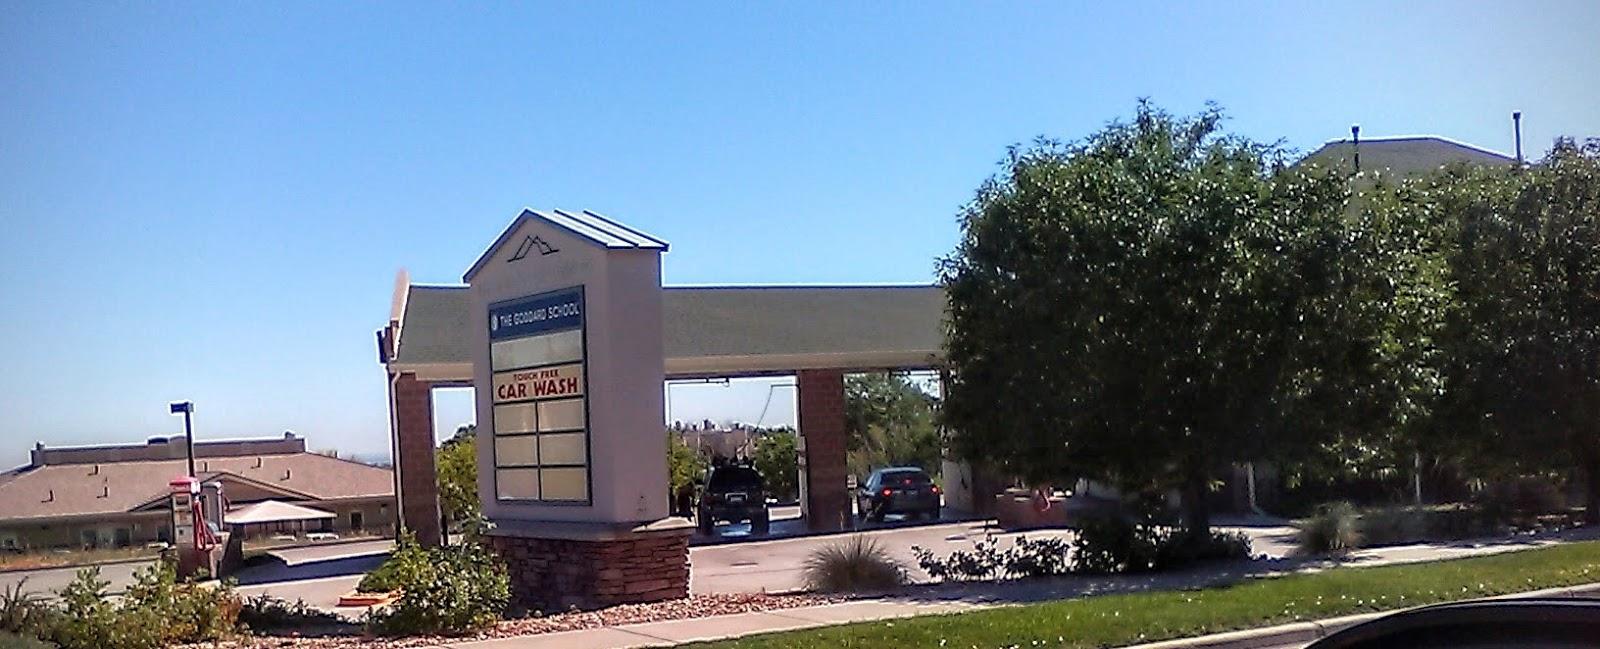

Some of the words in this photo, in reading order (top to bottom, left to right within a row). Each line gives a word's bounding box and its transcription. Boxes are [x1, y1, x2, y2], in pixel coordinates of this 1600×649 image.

[500, 314, 513, 326] THE
[513, 308, 546, 325] GODDARD
[548, 302, 580, 319] SCHOOL
[513, 372, 538, 381] TOUCH
[540, 369, 559, 379] FREE
[497, 383, 527, 399] CAR
[533, 377, 578, 396] WASH
